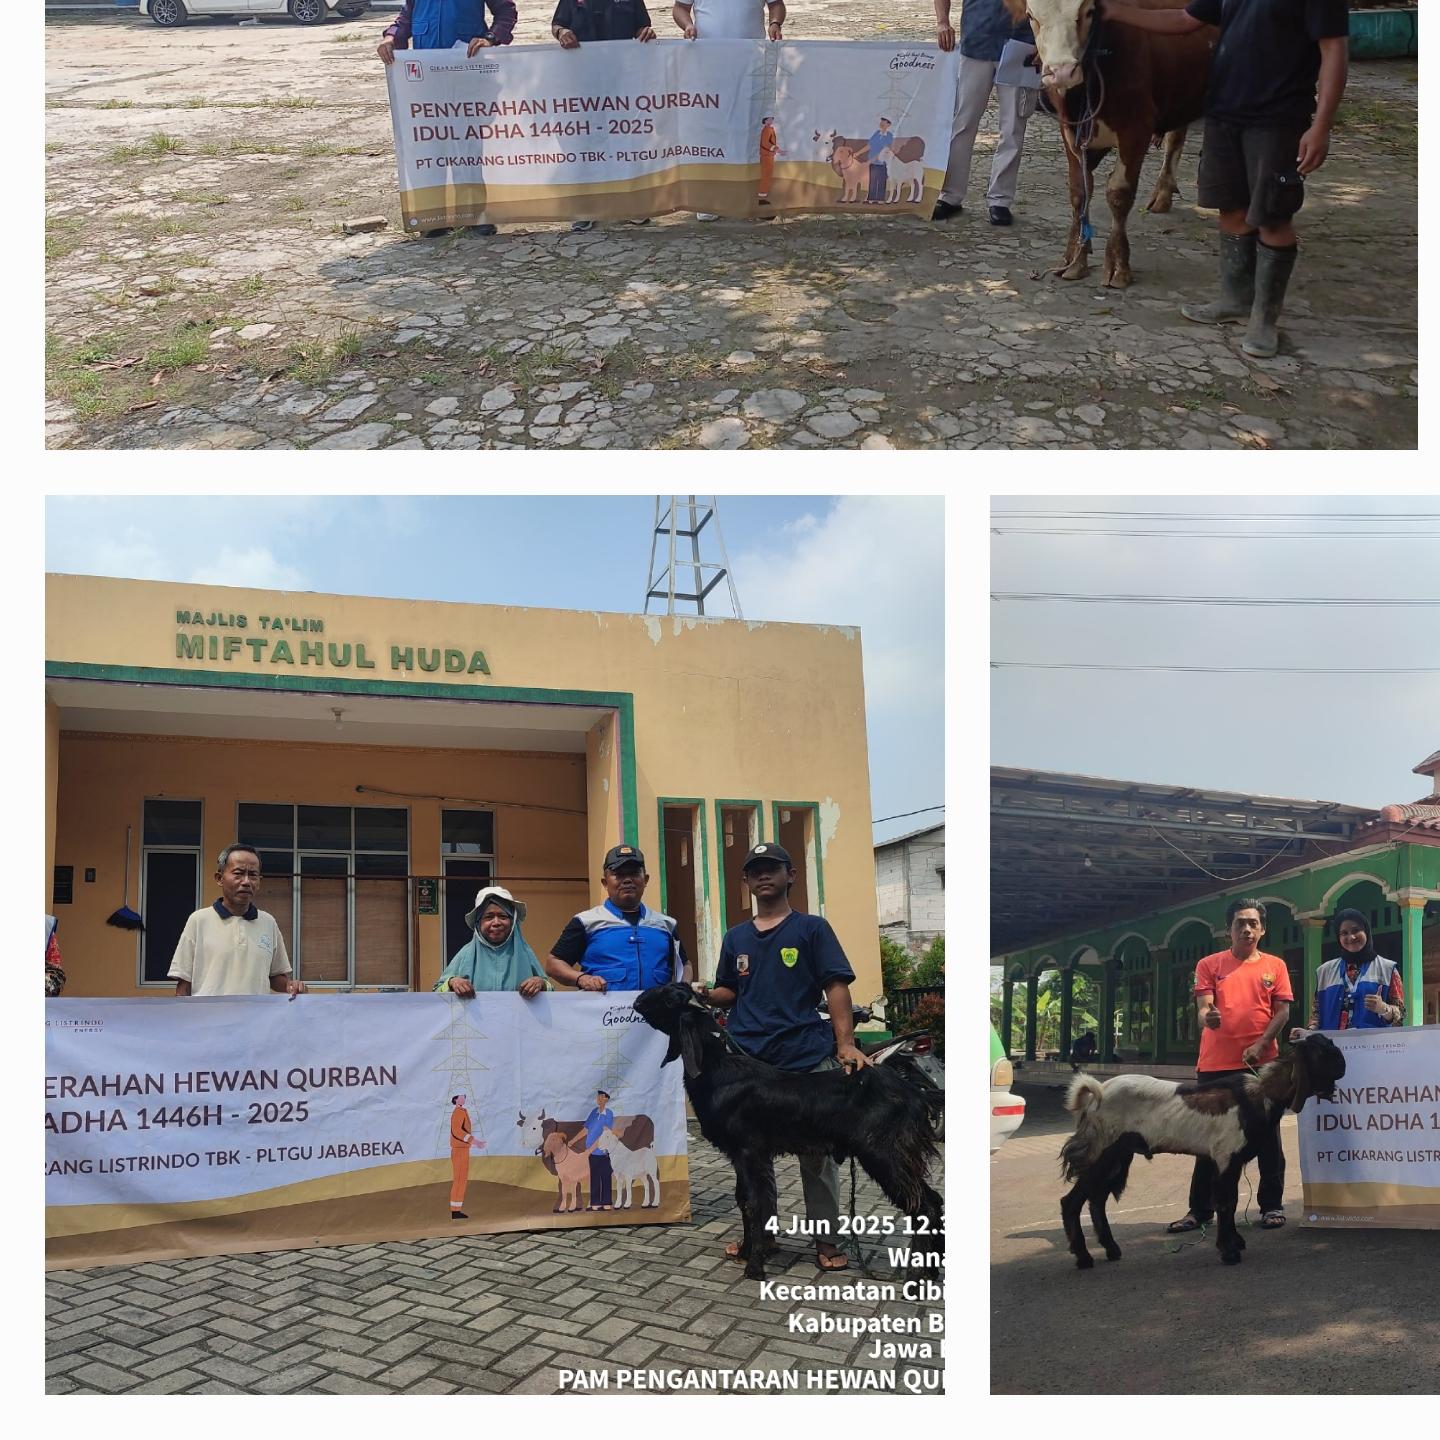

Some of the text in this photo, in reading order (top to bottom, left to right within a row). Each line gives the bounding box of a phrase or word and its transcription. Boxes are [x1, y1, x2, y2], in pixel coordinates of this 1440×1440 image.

[889, 56, 935, 70] Goodness
[410, 92, 720, 118] PENYERAHAN HEWAN QURBAN
[413, 119, 654, 141] IDUL ADHA 1446H 2025
[416, 145, 725, 169] PT CIKARANG LISTRINDO TBK PLTGU JABABEKA
[176, 610, 324, 633] MAJLIS TA'LIM
[175, 633, 491, 675] MIFTAHUL HUDA
[603, 1010, 647, 1026] Goodne
[174, 1069, 278, 1094] HEWAN
[286, 1065, 397, 1090] QURBAN
[137, 1105, 222, 1130] 1446H
[248, 1101, 309, 1125] 2025
[1316, 1113, 1363, 1132] IDUL
[1366, 1112, 1424, 1131] ADHA
[99, 1153, 200, 1173] LISTRINDO
[206, 1150, 240, 1166] TBK
[256, 1146, 312, 1164] PLTGU
[316, 1141, 404, 1161] JABABEKA
[1318, 1151, 1334, 1163] PT
[1338, 1148, 1404, 1163] CIKARANG
